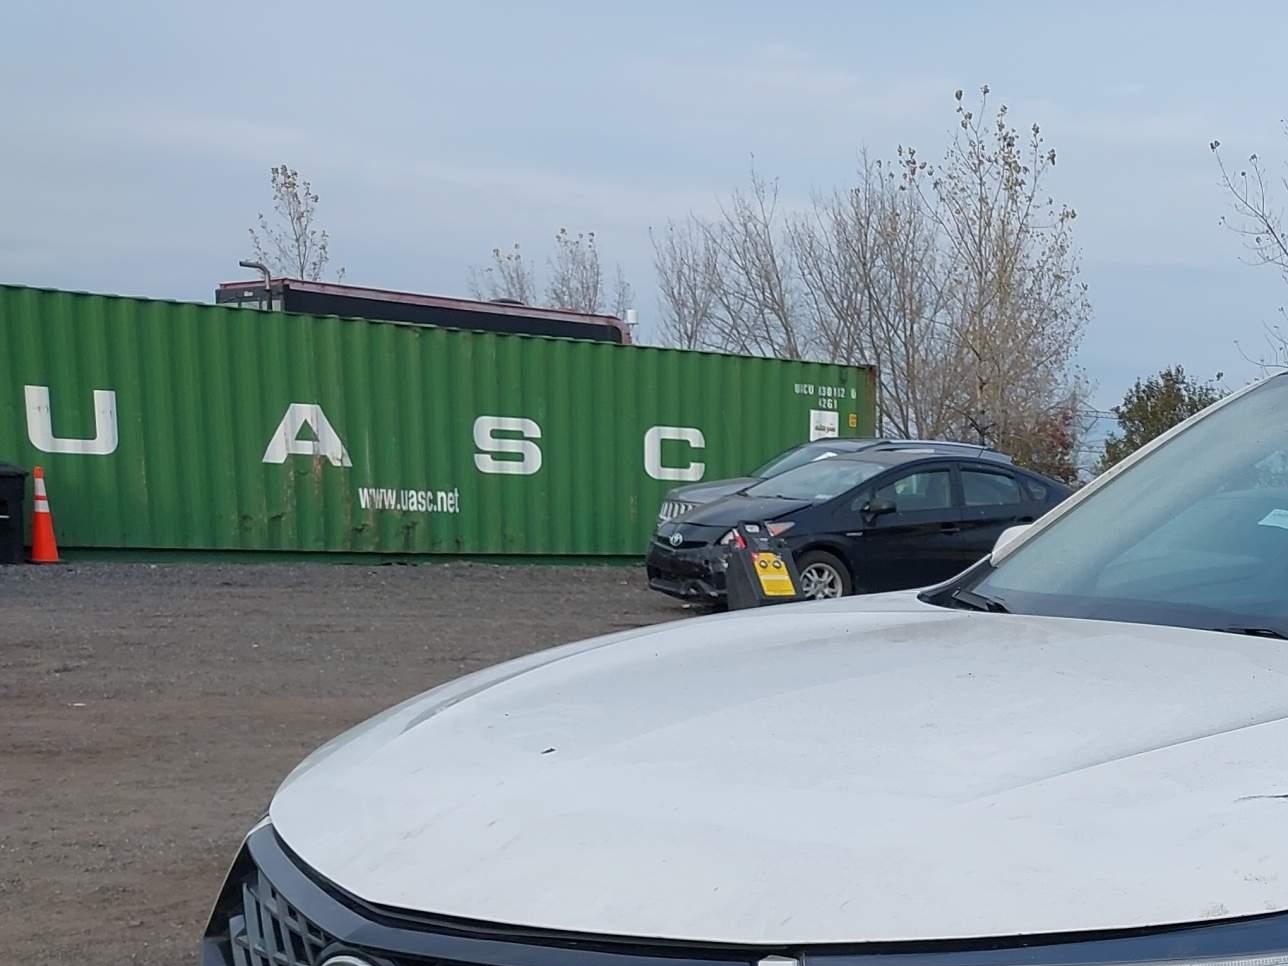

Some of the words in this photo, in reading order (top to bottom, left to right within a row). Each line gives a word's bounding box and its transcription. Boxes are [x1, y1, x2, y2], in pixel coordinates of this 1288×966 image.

[25, 386, 118, 455] U
[262, 404, 352, 467] A
[474, 416, 542, 475] S
[645, 426, 705, 481] C
[359, 488, 459, 512] www.uasc.net
